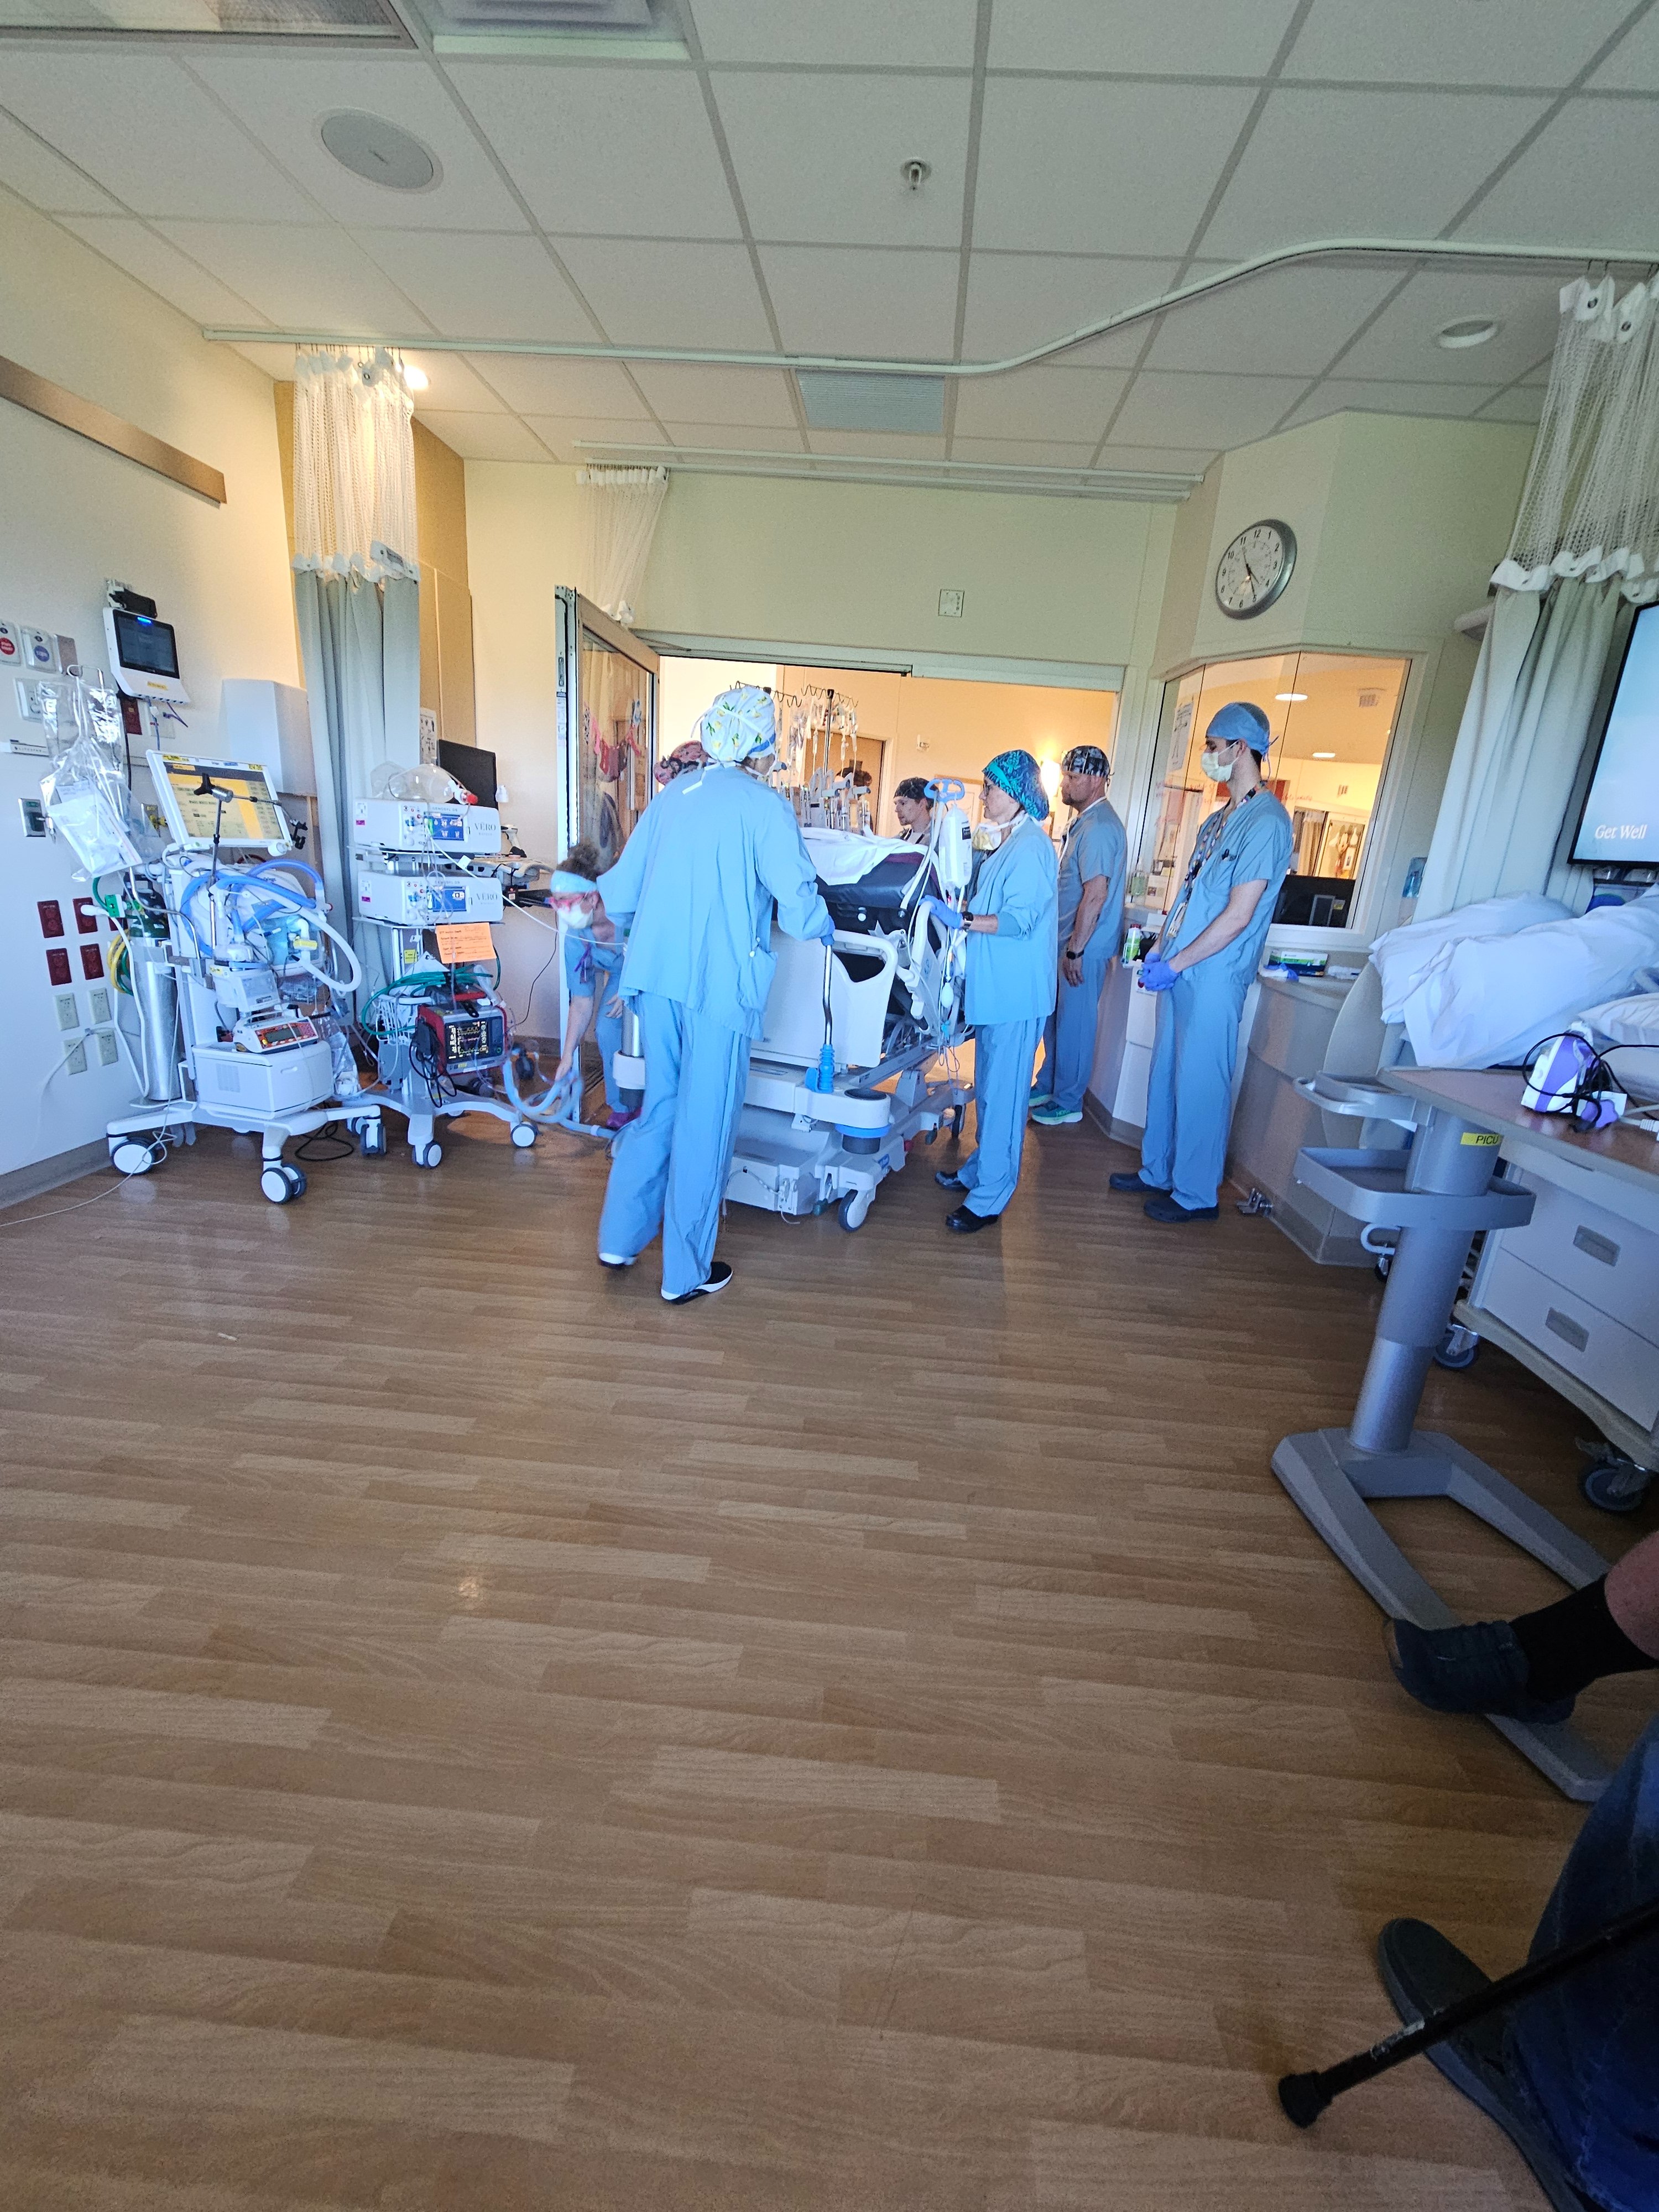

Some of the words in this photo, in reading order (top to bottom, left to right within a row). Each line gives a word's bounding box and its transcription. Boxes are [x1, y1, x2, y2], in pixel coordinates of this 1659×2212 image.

[1254, 529, 1261, 538] 12
[1267, 530, 1272, 539] 1
[1240, 536, 1246, 545] 11
[1274, 543, 1280, 552] 2
[1228, 551, 1234, 560] 10
[1273, 561, 1277, 570] 3
[1222, 568, 1227, 576] 9
[1265, 579, 1270, 587] 4
[1220, 585, 1225, 593] 8
[1228, 597, 1233, 605] 7
[1239, 599, 1244, 608] 6
[1595, 825, 1618, 839] Get
[1620, 824, 1647, 839] Well
[1476, 1135, 1499, 1145] PICU
